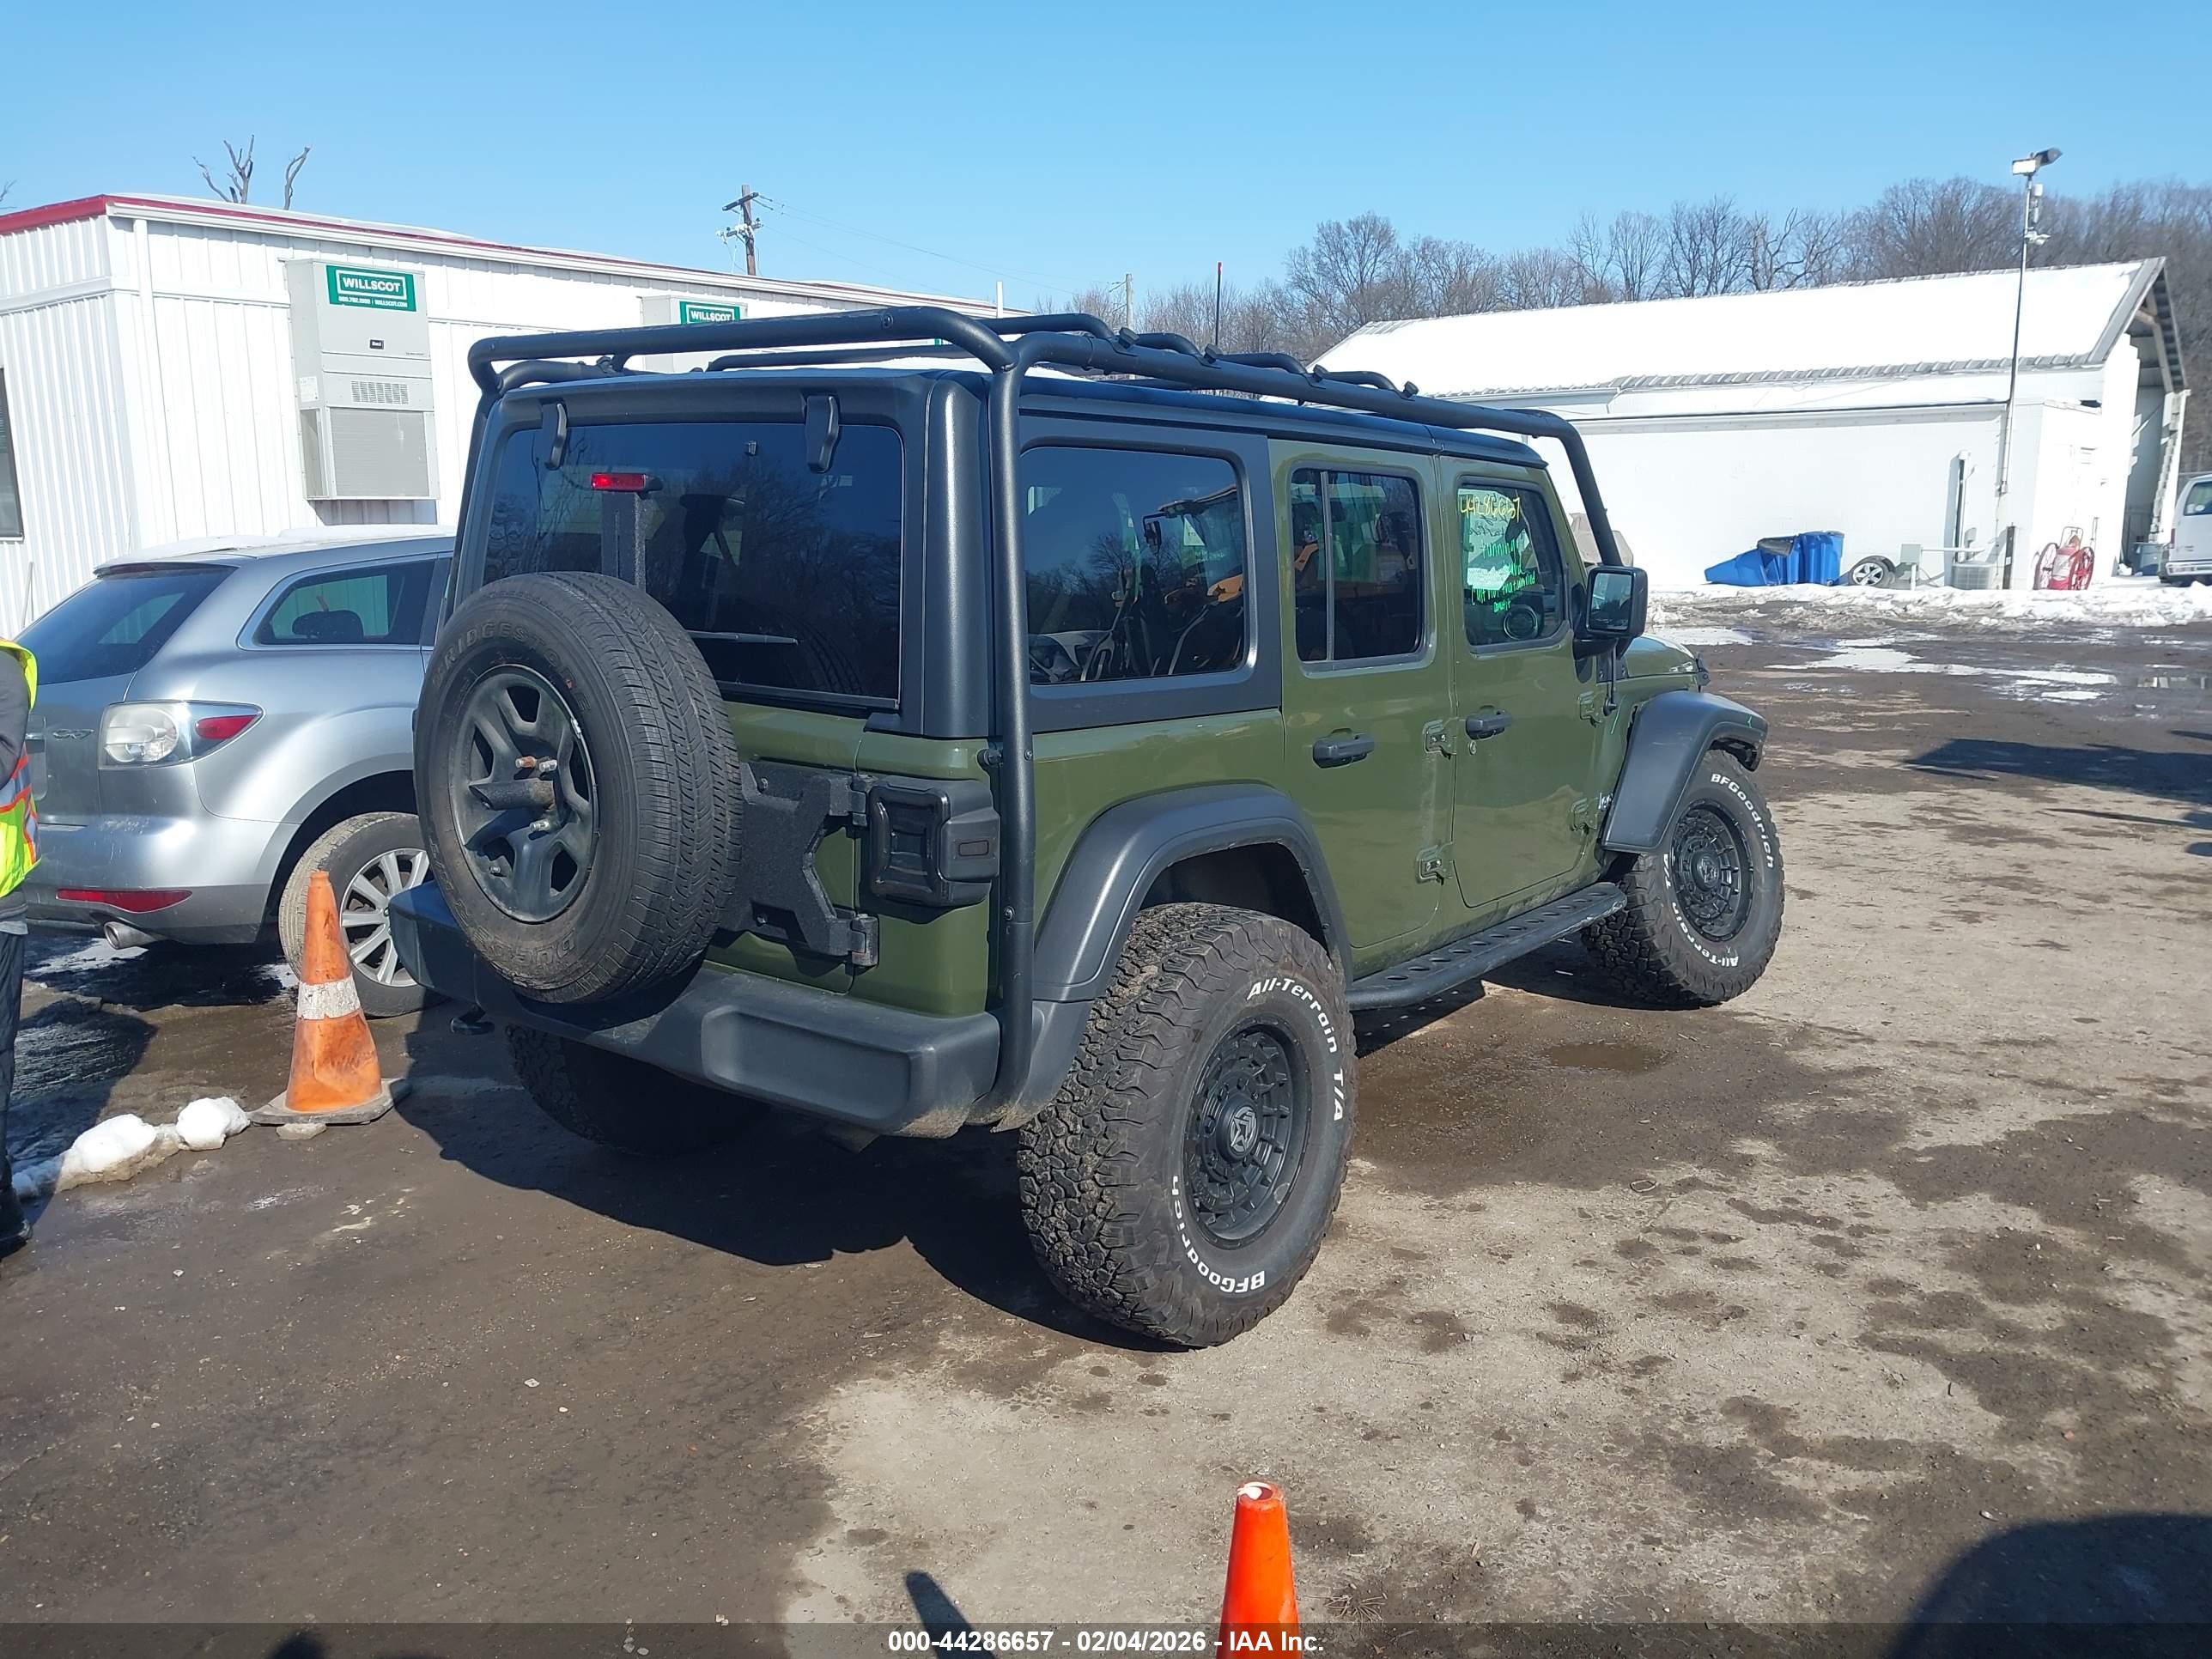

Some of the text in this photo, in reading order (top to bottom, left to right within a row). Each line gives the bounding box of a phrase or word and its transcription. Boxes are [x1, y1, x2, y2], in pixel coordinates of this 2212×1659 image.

[343, 277, 400, 292] WILLSCOT
[690, 310, 732, 322] WILLSCOT
[1711, 773, 1774, 868] BFGoodrich
[1672, 902, 1739, 968] All-Terrain
[1246, 976, 1344, 1121] All-Terrain T/A
[1171, 1176, 1267, 1294] BFGoodrich
